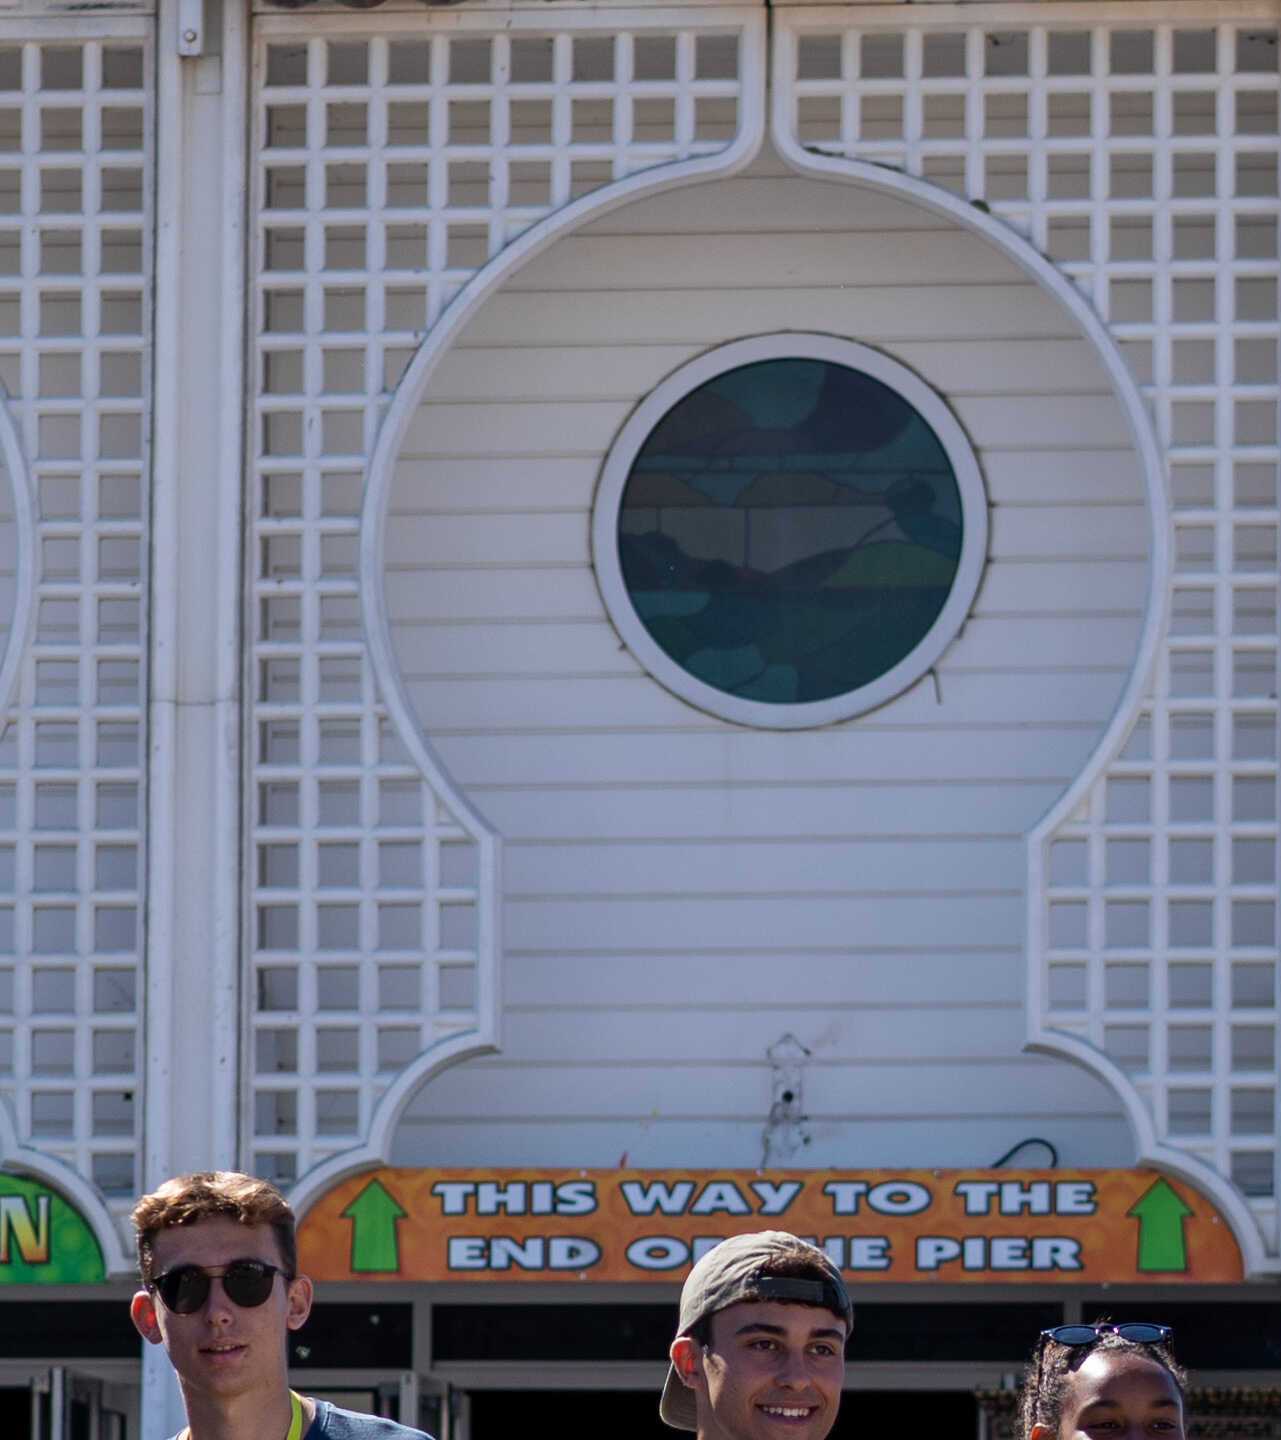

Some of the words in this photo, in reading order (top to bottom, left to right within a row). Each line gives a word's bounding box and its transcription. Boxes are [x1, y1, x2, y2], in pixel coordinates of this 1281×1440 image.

[432, 1182, 597, 1214] THIS
[621, 1181, 804, 1214] WAY
[823, 1182, 930, 1214] TO
[954, 1182, 1097, 1214] THE
[447, 1236, 601, 1269] END
[915, 1236, 1081, 1269] PIER
